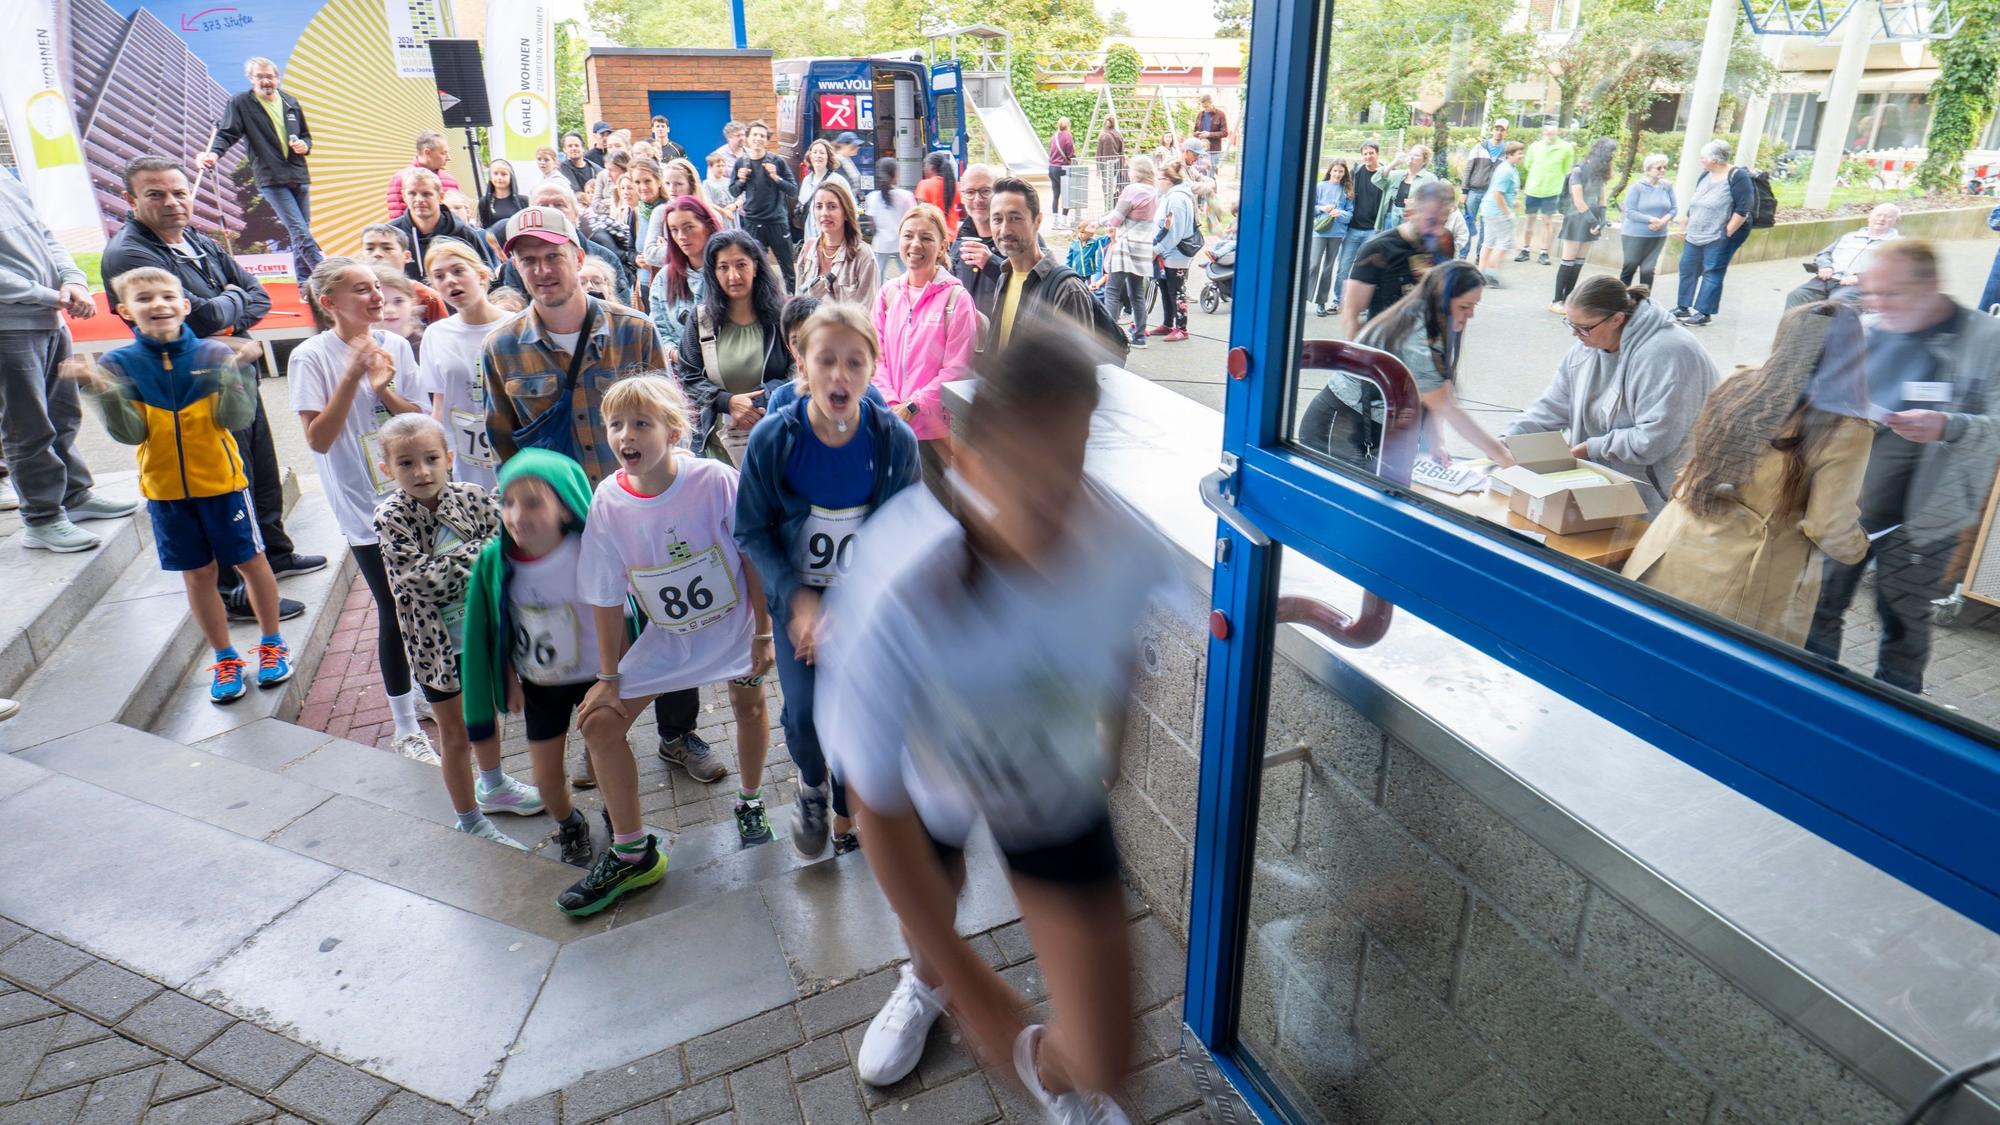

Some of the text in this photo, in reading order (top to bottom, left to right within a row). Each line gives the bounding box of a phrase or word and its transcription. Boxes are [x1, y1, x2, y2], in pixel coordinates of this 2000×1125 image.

[202, 19, 221, 32] 373
[520, 37, 532, 134] SAHLE WOHNEN
[658, 574, 714, 620] 86
